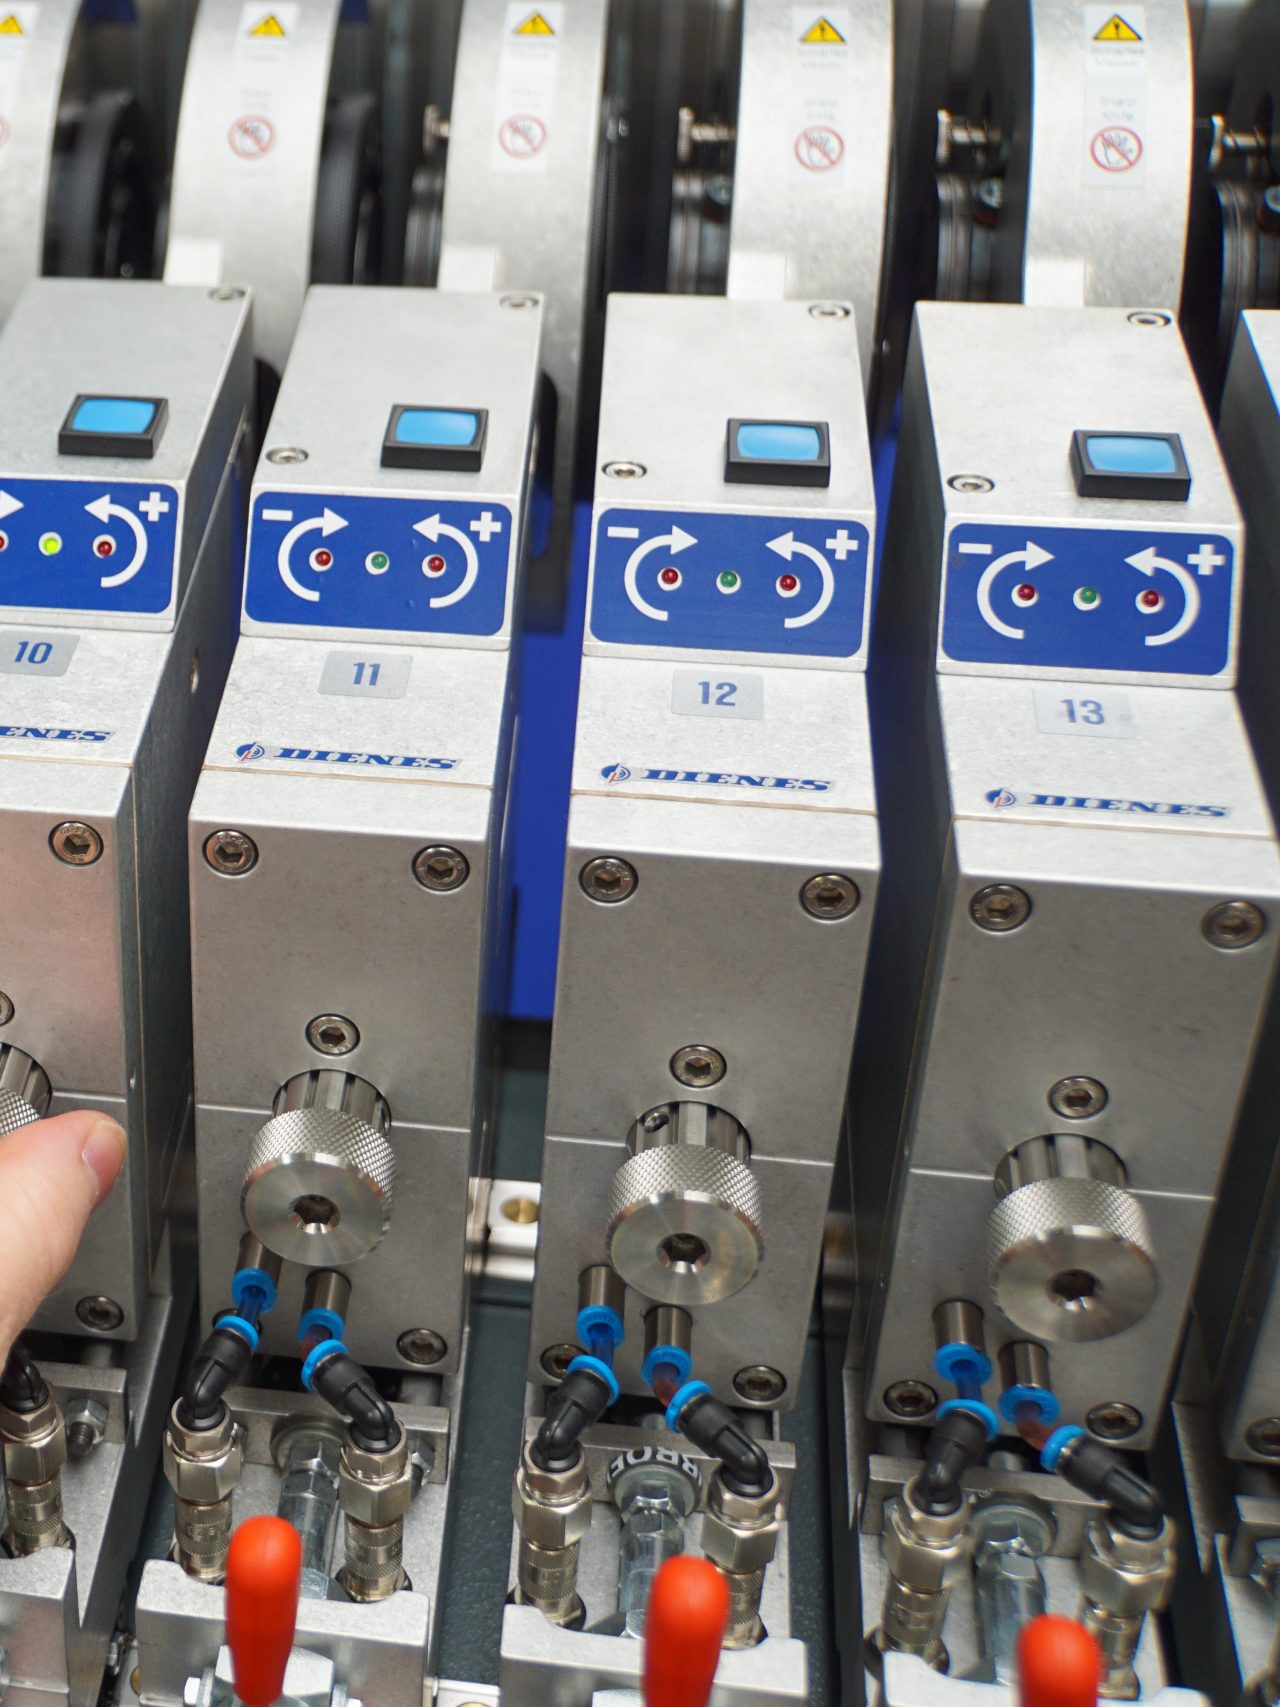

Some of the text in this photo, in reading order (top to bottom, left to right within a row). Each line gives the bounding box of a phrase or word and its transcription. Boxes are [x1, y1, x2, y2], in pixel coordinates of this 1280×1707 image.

[14, 640, 54, 665] 10
[352, 662, 381, 686] 11
[698, 680, 738, 707] 12
[1060, 698, 1105, 725] 13
[273, 746, 457, 770] DIENES
[640, 767, 831, 791] DIENES
[1026, 793, 1228, 818] DIENES
